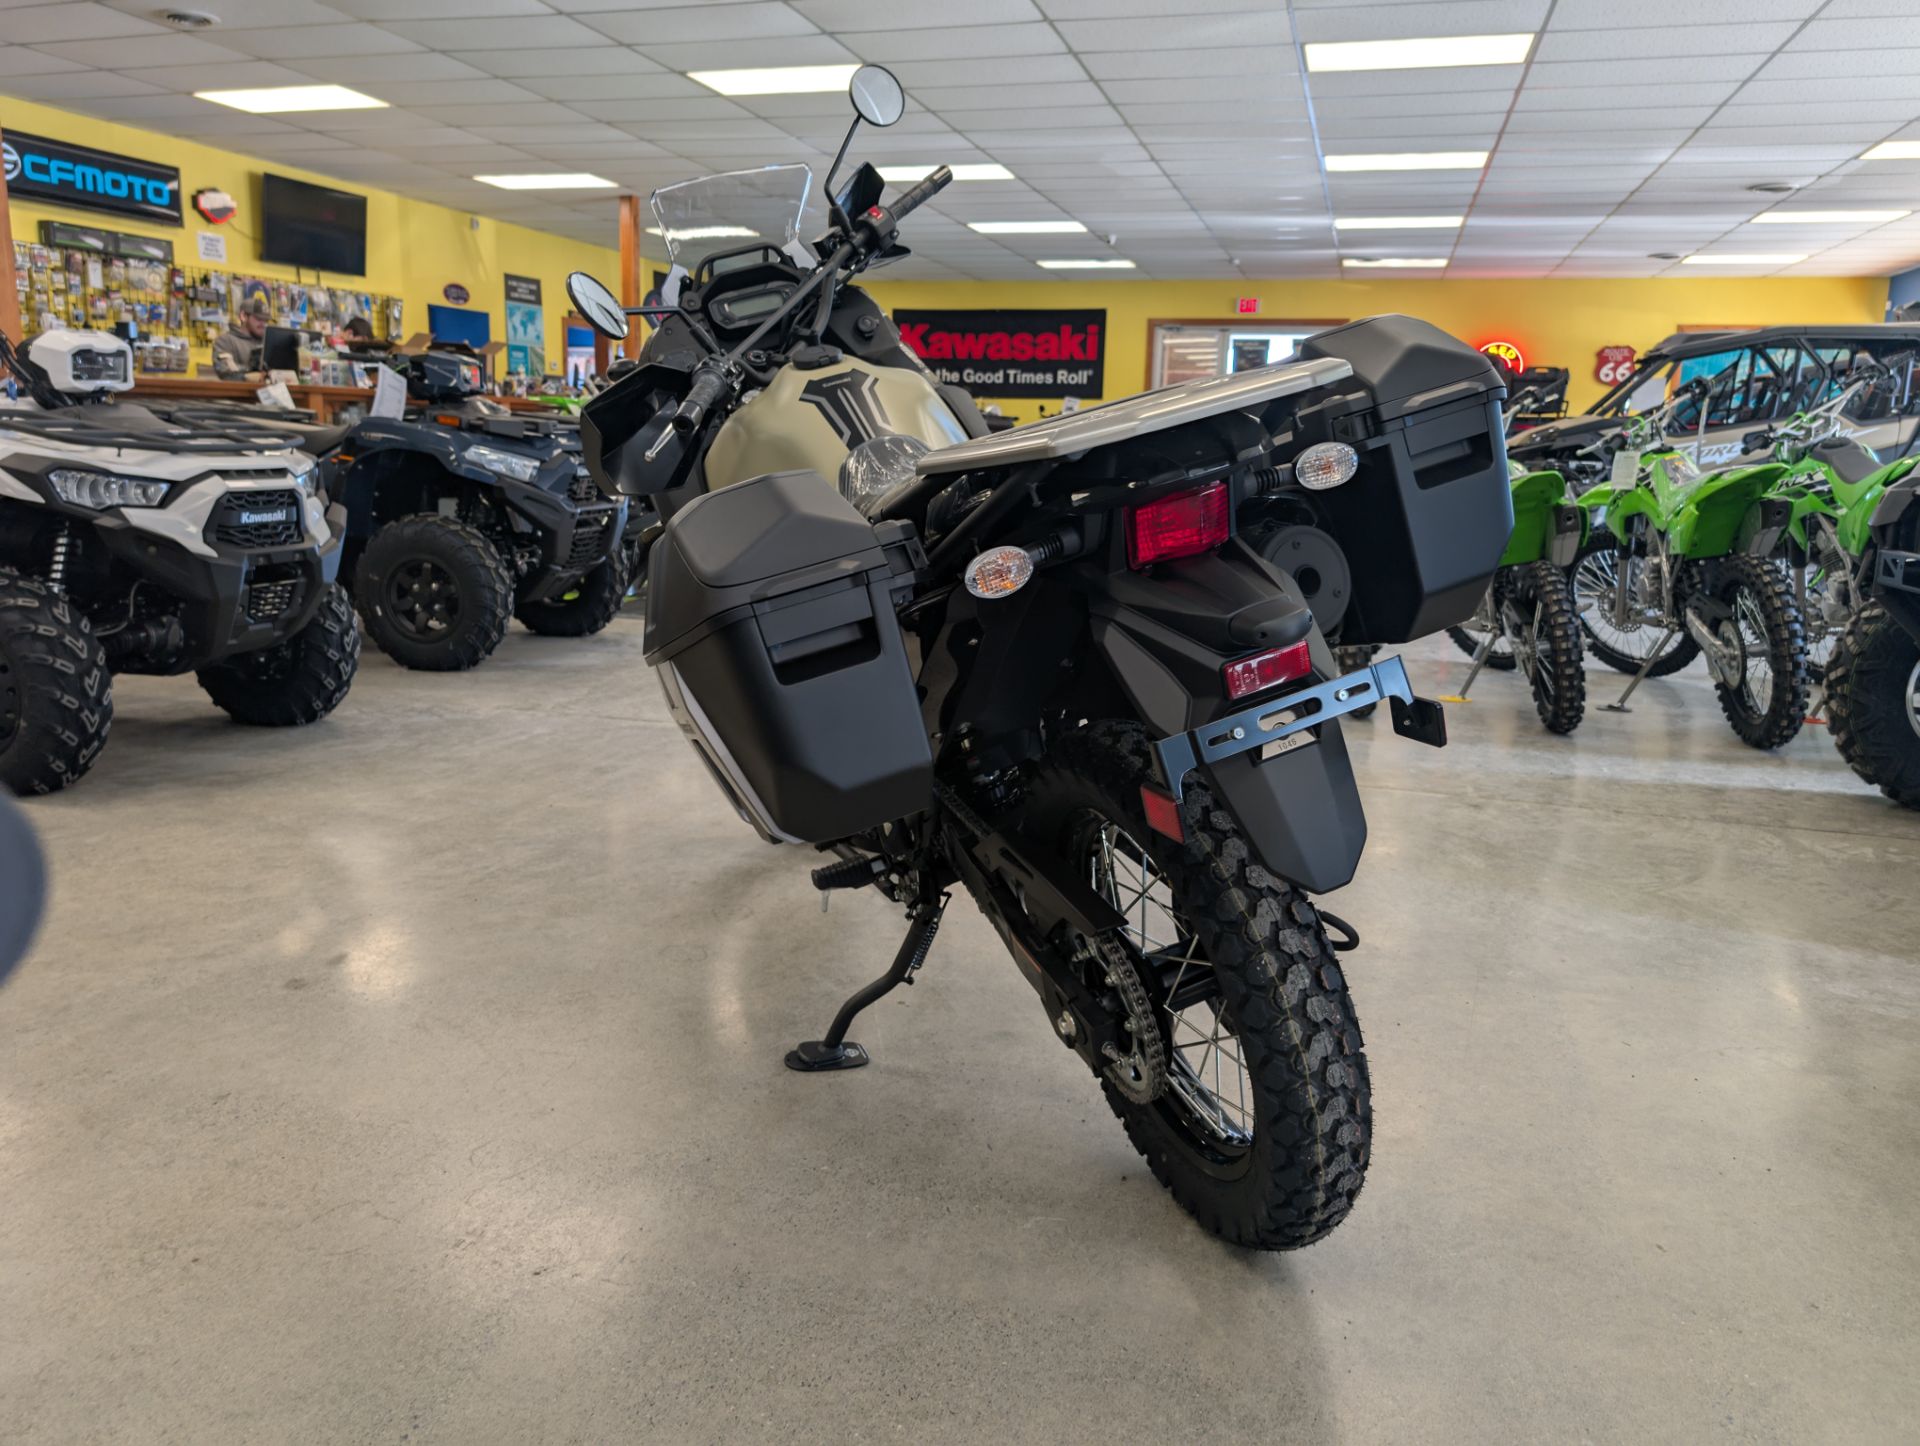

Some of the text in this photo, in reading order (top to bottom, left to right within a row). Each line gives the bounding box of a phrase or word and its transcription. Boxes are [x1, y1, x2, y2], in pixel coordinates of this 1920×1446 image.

[23, 153, 171, 206] CFMOTO
[1239, 297, 1257, 313] EXIT
[900, 323, 1099, 361] Kawasaki
[963, 369, 1003, 384] Good
[1006, 370, 1053, 384] Times
[1599, 361, 1631, 382] 66
[241, 509, 286, 524] Kawasaki
